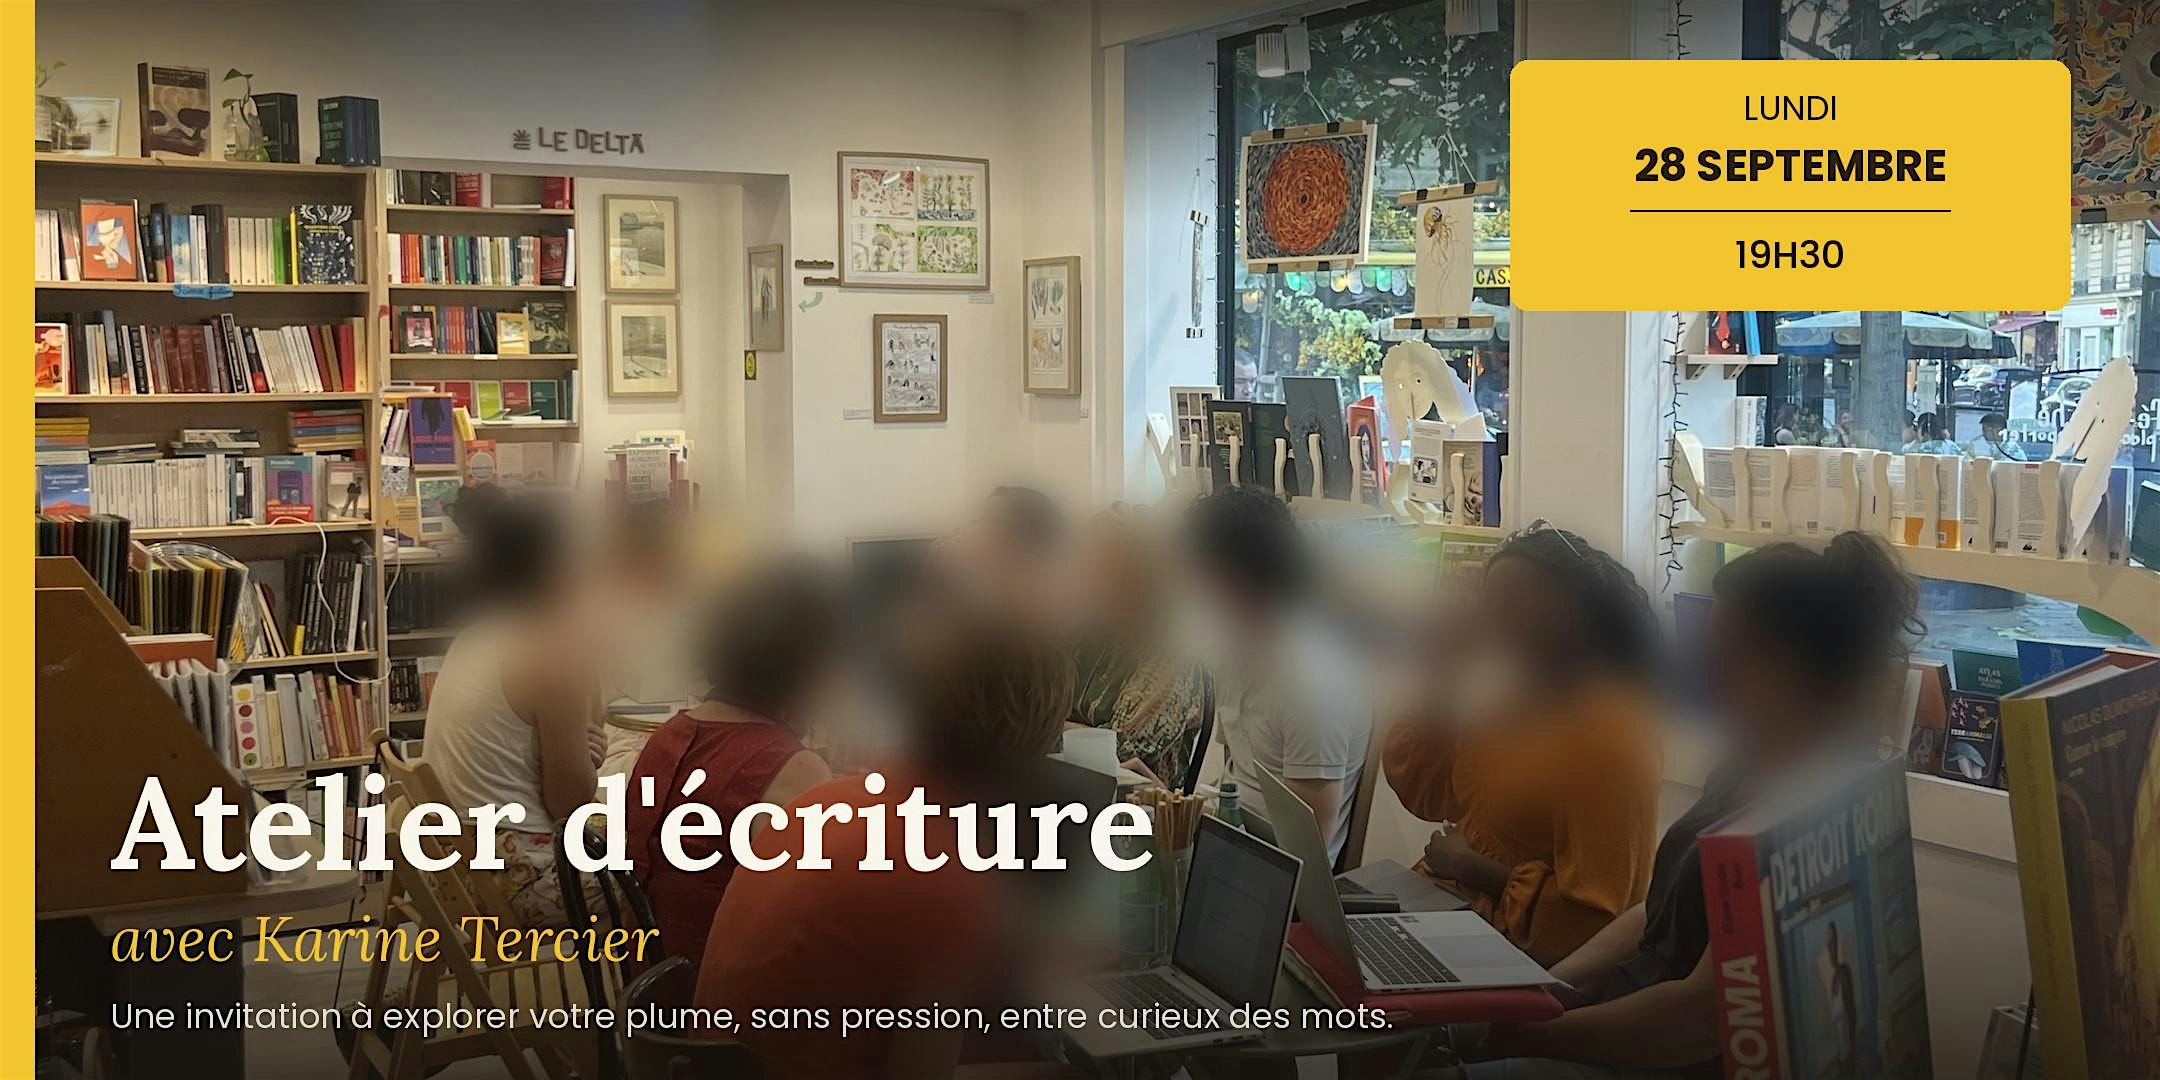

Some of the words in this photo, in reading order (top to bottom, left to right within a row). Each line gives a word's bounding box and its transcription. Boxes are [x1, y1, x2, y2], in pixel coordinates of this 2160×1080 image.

[538, 126, 568, 152] LE
[575, 128, 645, 155] DELTA
[1476, 268, 1510, 285] CAS
[1769, 809, 1849, 912] DETROIT
